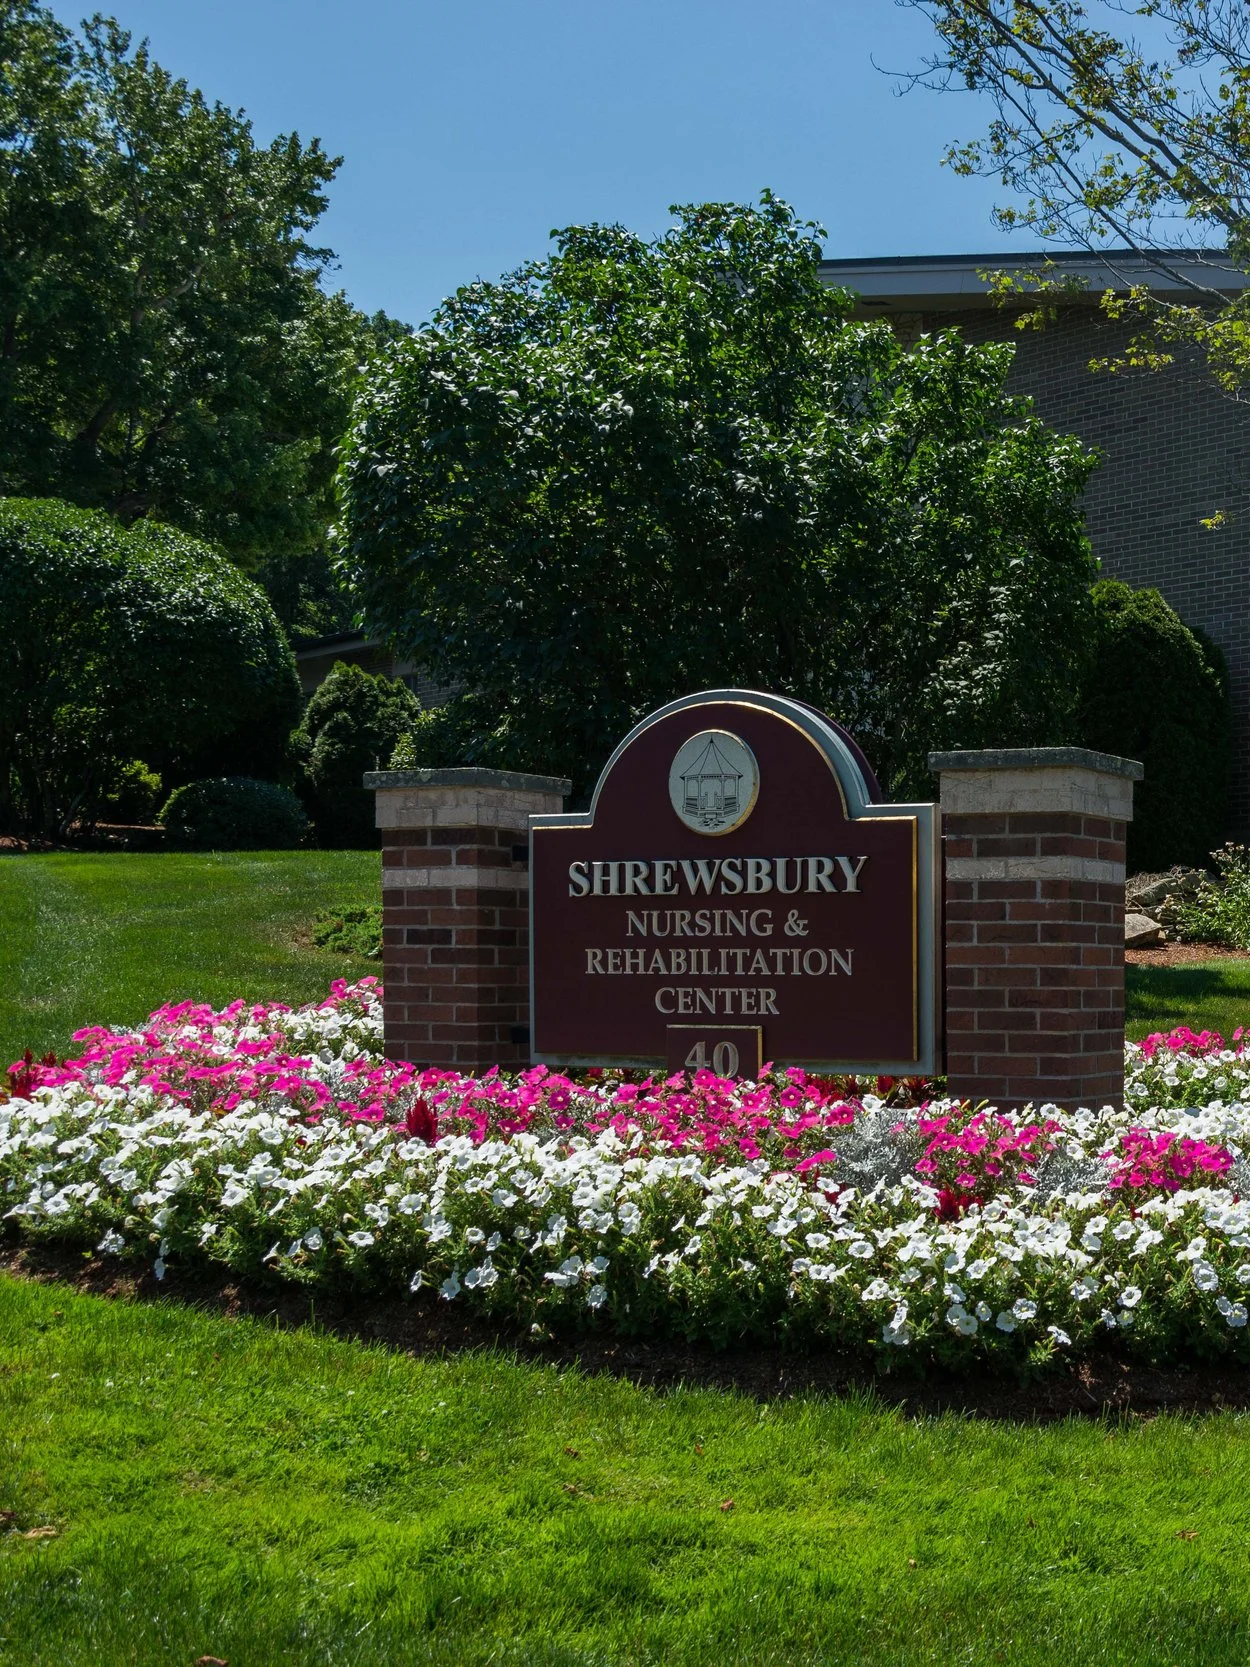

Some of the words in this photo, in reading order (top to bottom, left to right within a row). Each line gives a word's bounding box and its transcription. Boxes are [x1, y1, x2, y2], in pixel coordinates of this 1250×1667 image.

[568, 855, 869, 897] SHREWSBURY
[626, 909, 774, 937] NURSING
[783, 909, 809, 937] &
[585, 948, 855, 976] REHABILITATION
[654, 987, 780, 1015] CENTER
[684, 1041, 740, 1079] 40
